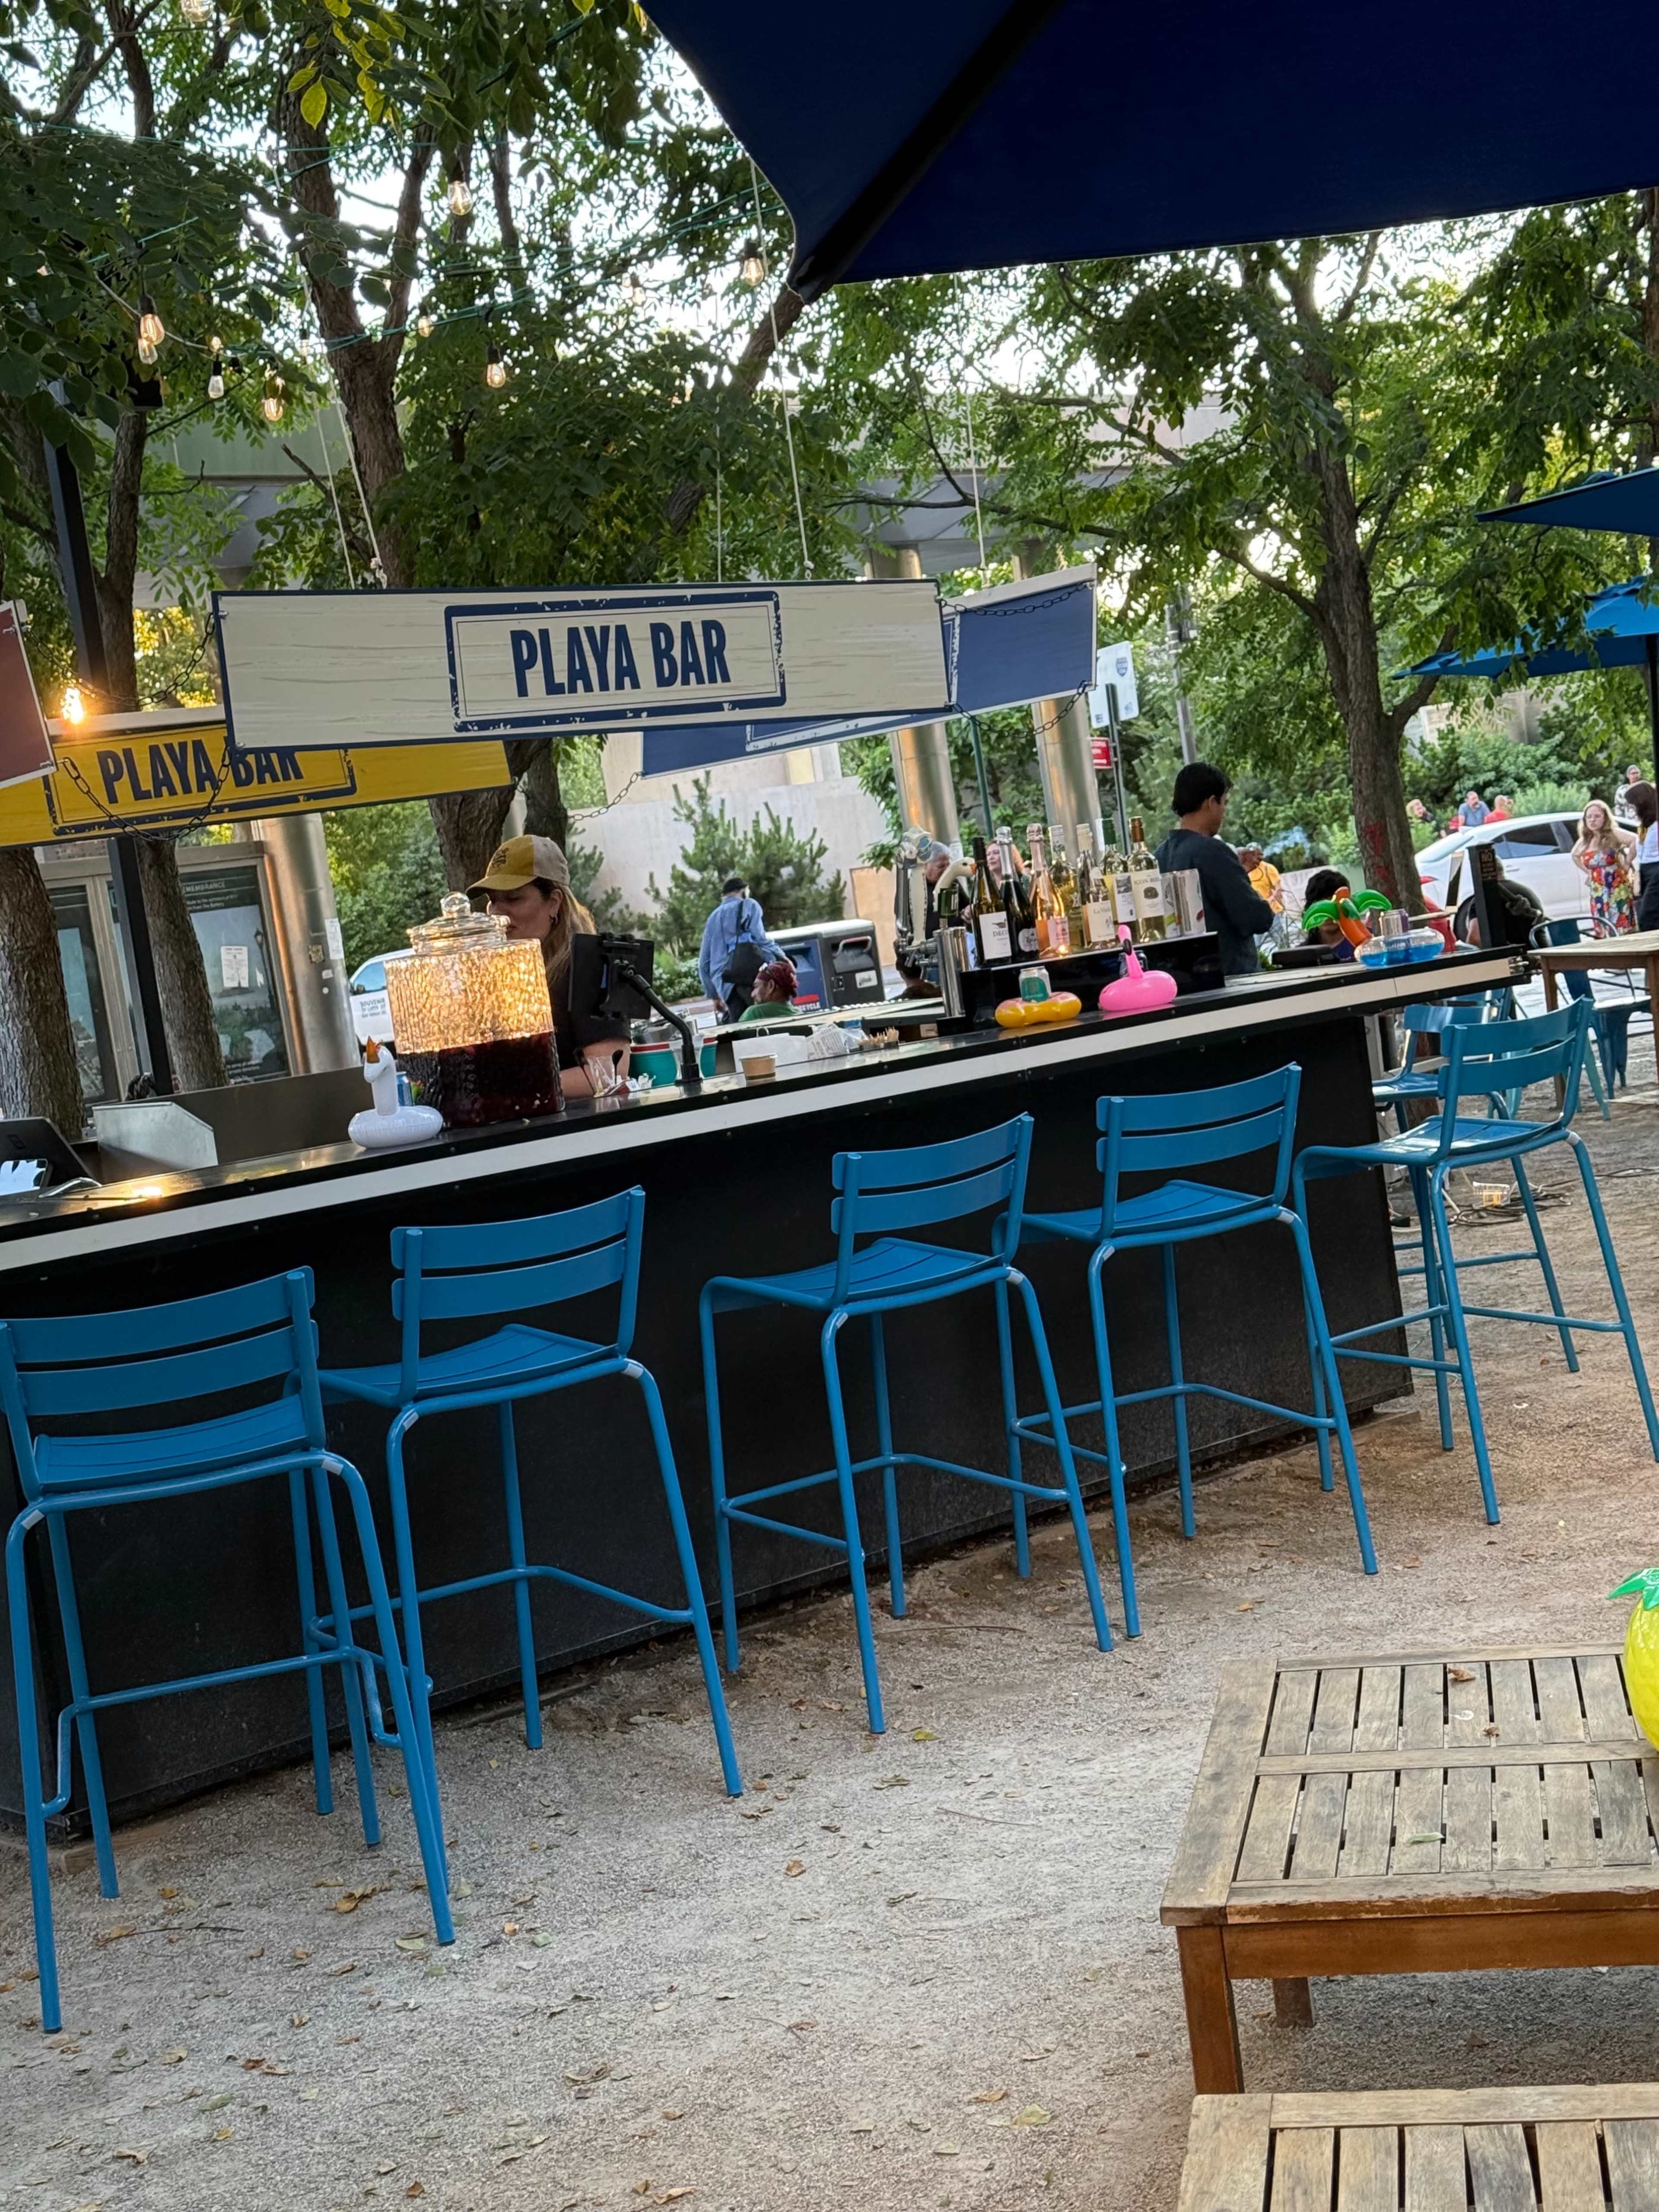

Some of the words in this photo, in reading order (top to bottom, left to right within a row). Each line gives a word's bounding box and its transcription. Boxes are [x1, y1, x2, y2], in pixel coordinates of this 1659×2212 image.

[510, 624, 641, 697] PLAYA
[649, 619, 731, 688] BAR
[96, 739, 219, 804] PLAYA
[183, 881, 226, 892] EMEMBRANCE
